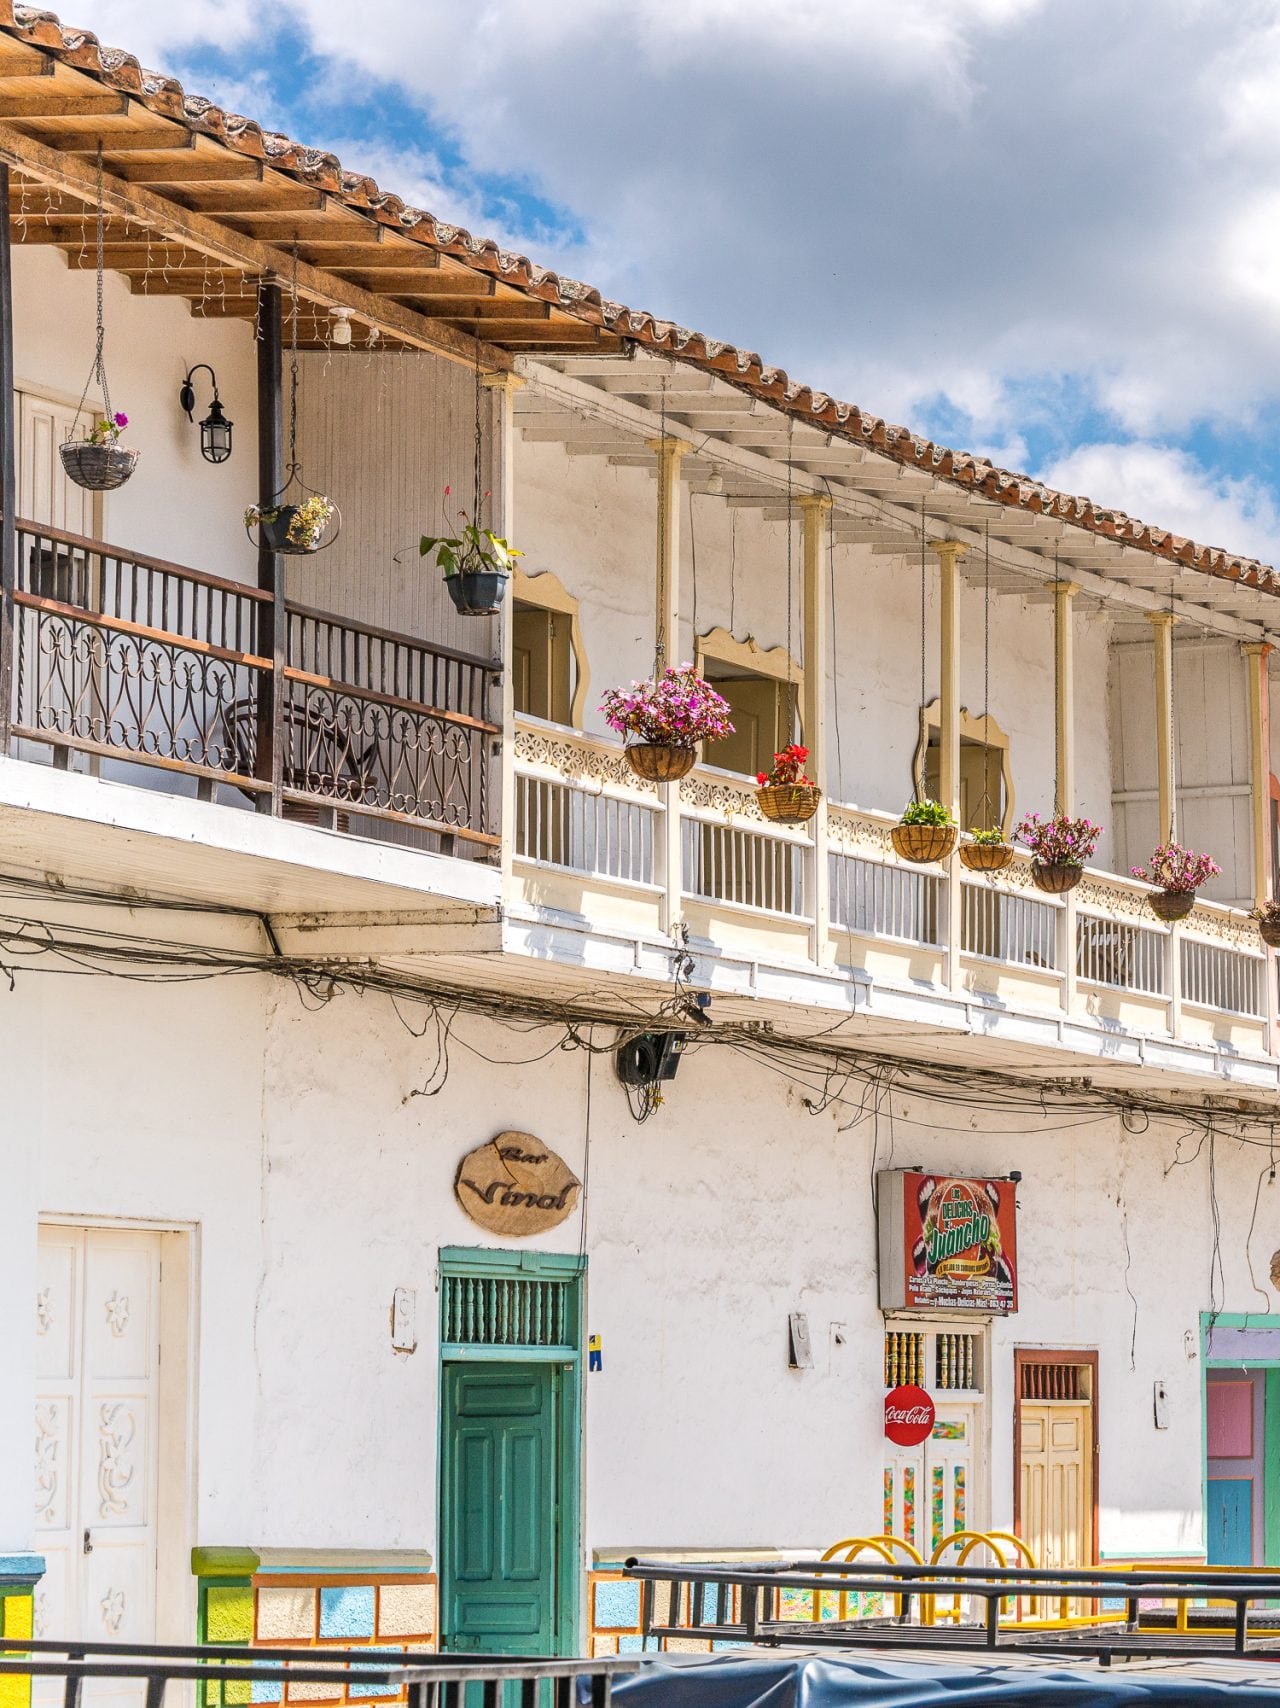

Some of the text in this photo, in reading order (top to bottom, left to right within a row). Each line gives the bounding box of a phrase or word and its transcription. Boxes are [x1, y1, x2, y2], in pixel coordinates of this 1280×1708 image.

[500, 1146, 548, 1164] Bar
[942, 1200, 973, 1219] DELICIAS
[944, 1220, 950, 1229] DE
[928, 1211, 990, 1264] Juancho
[938, 1296, 957, 1306] Muchas
[957, 1297, 975, 1307] Delicias
[885, 1406, 933, 1424] Coca-Cola
